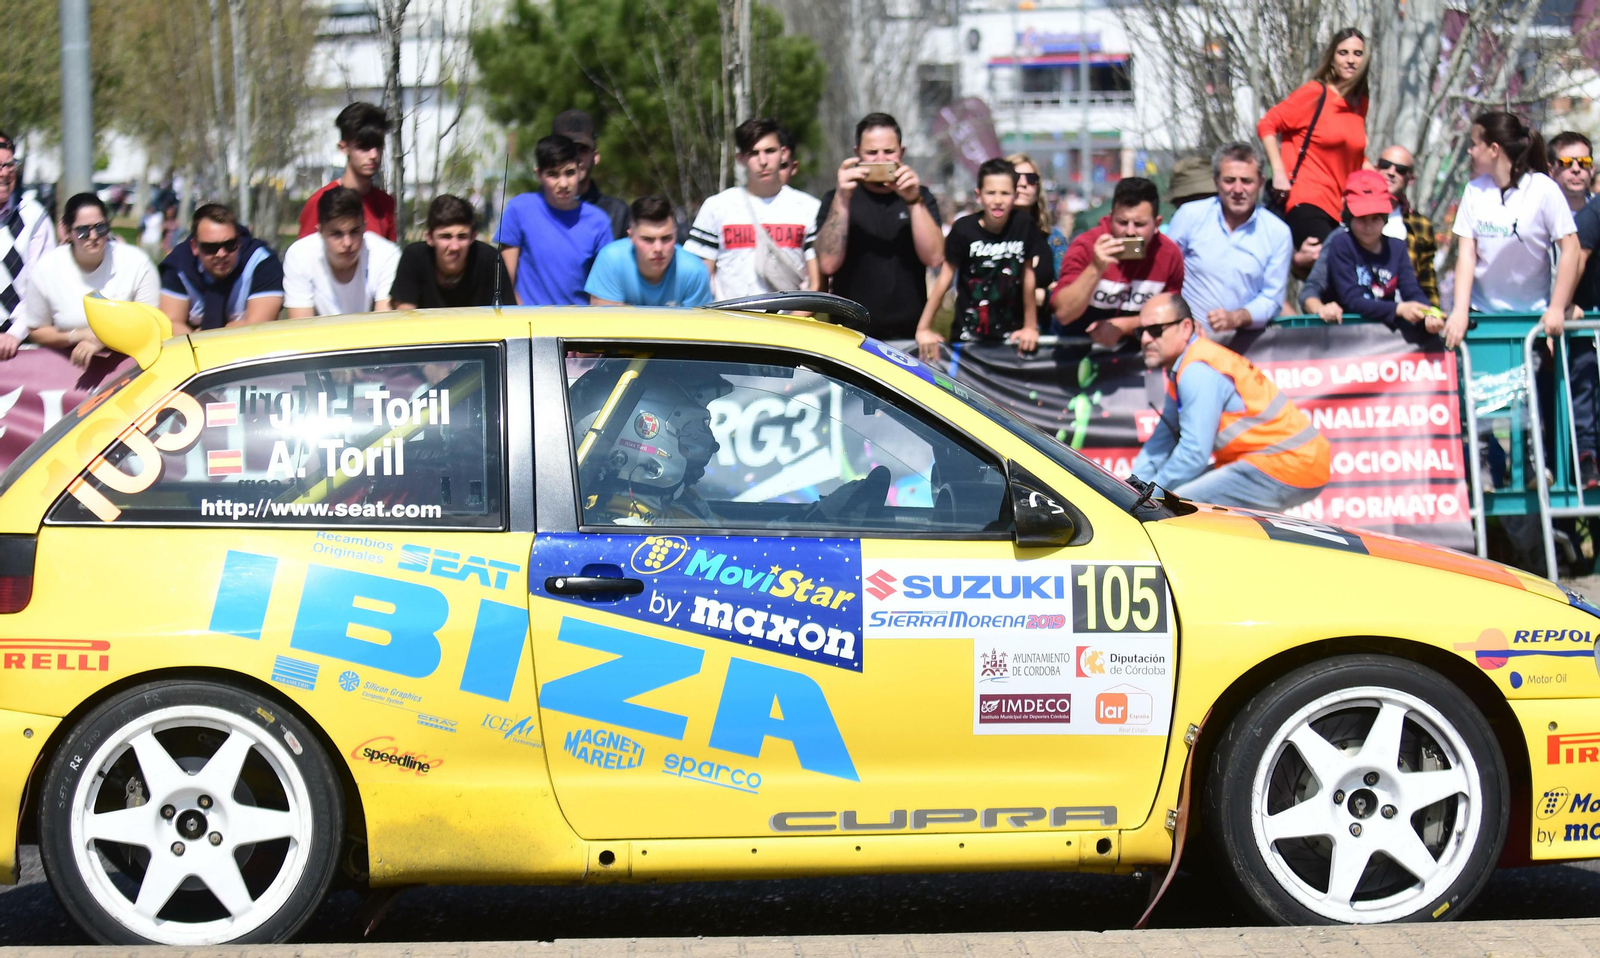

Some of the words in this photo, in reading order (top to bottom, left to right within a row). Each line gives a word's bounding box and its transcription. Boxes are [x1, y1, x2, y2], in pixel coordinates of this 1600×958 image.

[1330, 360, 1448, 384] LABORAL
[364, 389, 450, 427] Toril
[1302, 403, 1450, 430] NALIZADO
[266, 440, 306, 478] A.
[318, 437, 405, 477] Toril
[1331, 449, 1454, 475] OCIONAL
[200, 499, 441, 520] http://www.seat.com
[1331, 493, 1459, 519] FORMATO
[312, 542, 384, 564] Originales
[397, 543, 521, 590] SEAT
[684, 548, 856, 610] MoviStar
[903, 575, 1064, 599] SUZUKI
[1077, 564, 1160, 632] 105
[649, 590, 682, 622] by
[690, 595, 855, 660] maxon
[1026, 614, 1066, 629] 2019
[1513, 629, 1593, 643] REPSOL
[209, 550, 861, 782] IBIZA
[1012, 652, 1070, 664] AYUNTAMIENTO
[1110, 653, 1165, 664] Diputación
[1012, 666, 1023, 677] DE
[1110, 665, 1122, 675] de
[1125, 665, 1166, 676] Córdoba
[1527, 675, 1553, 684] Motor
[1556, 674, 1567, 683] Oil
[364, 682, 389, 694] Silicon
[390, 688, 423, 703] Graphics
[1002, 698, 1070, 713] IMDECO
[1099, 701, 1125, 719] lar
[363, 747, 430, 773] speedline
[664, 753, 762, 789] sparco
[769, 805, 1117, 832] CUPRA
[1537, 827, 1557, 847] by
